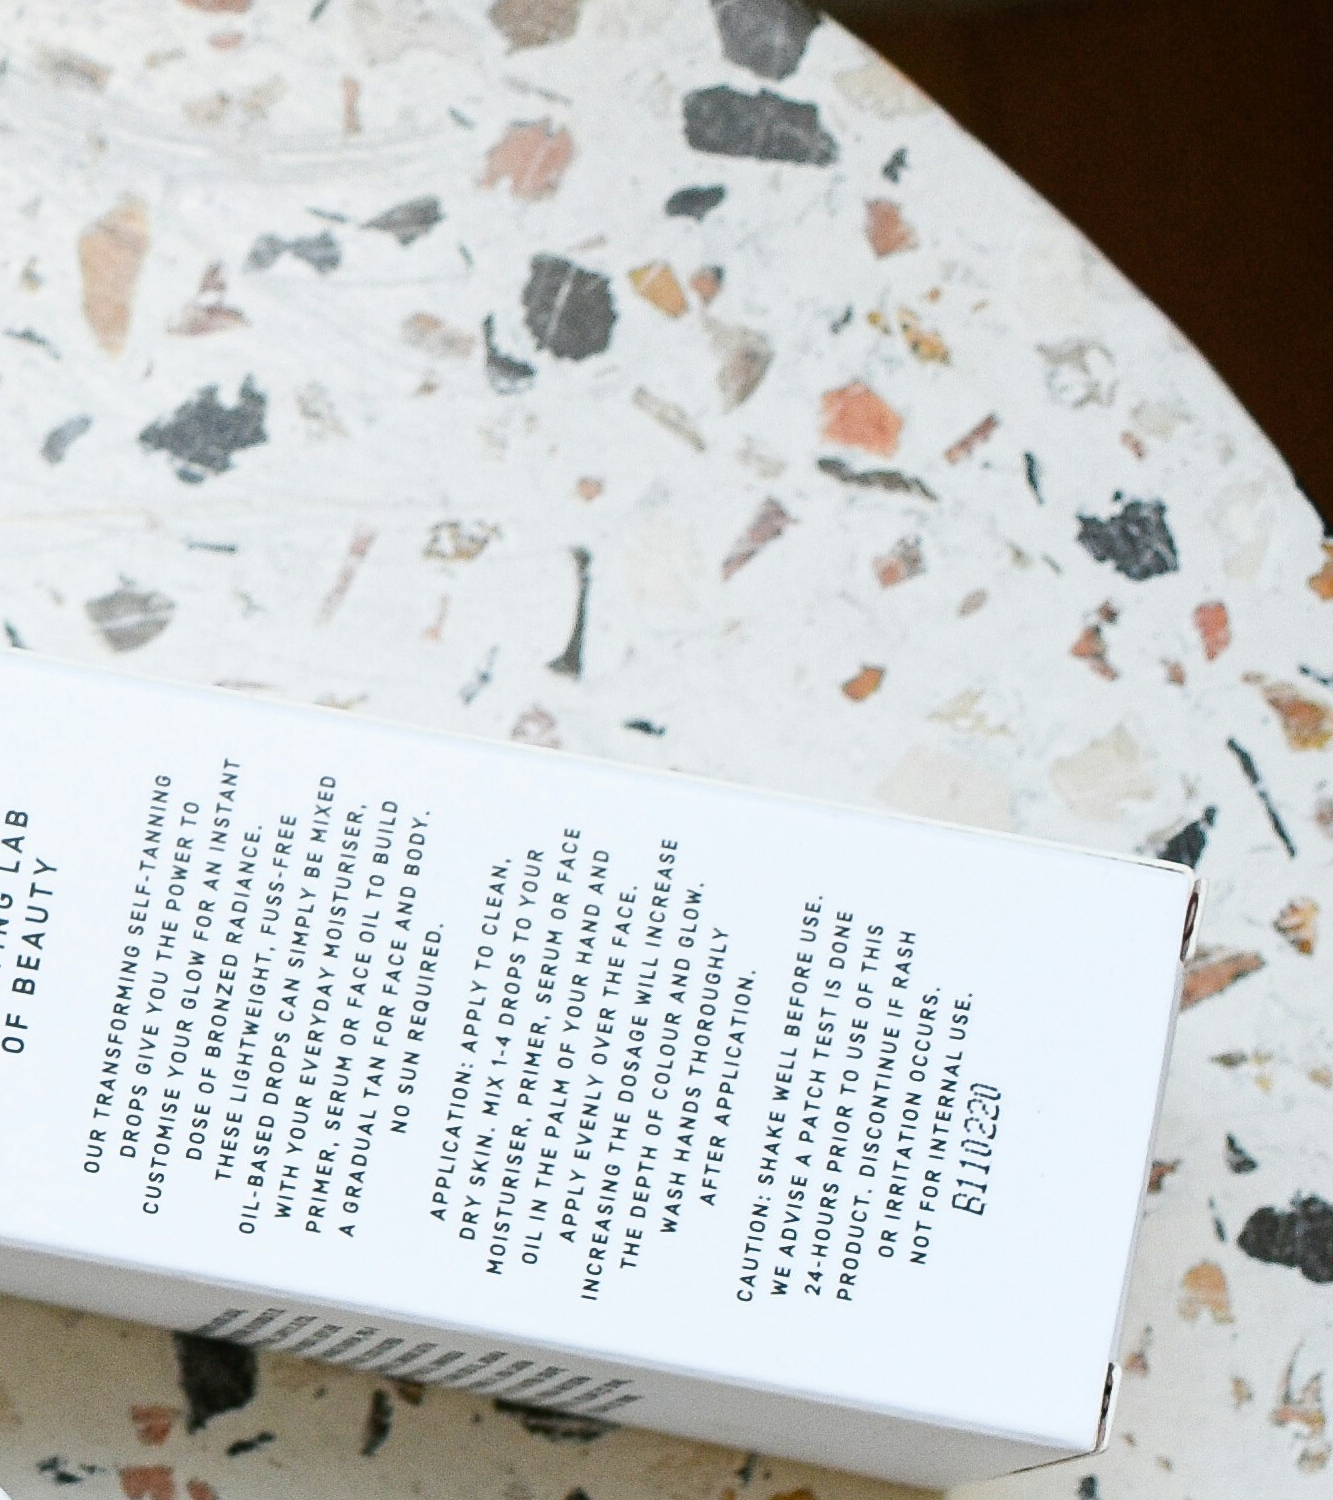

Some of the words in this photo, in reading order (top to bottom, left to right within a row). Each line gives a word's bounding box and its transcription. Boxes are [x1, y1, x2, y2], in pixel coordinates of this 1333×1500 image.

[178, 800, 200, 826] TO
[208, 757, 240, 852] INSTANT
[309, 774, 336, 843] MIXED
[371, 799, 398, 865] BUILD
[126, 773, 172, 936] SELF-TANNING
[164, 836, 194, 912] POWER
[202, 860, 222, 892] AN
[224, 824, 263, 945] RADIANCE.
[302, 851, 324, 879] BE
[321, 803, 367, 959] MOISTURISER,
[364, 873, 385, 900] TO
[555, 827, 581, 884] FACE
[191, 898, 216, 942] FOR
[480, 857, 511, 936] CLEAN,
[549, 891, 570, 920] OR
[610, 885, 638, 948] FACE.
[643, 838, 678, 948] INCREASE
[677, 882, 704, 948] GLOW.
[798, 894, 823, 943] USE.
[10, 856, 58, 996] BEAUTY
[154, 919, 179, 961] THE
[286, 886, 317, 969] SIMPLY
[357, 909, 380, 944] OIL
[473, 944, 494, 971] TO
[827, 910, 854, 970] DONE
[859, 923, 884, 973] THIS
[144, 969, 169, 1014] YOU
[179, 948, 206, 1010] GLOW
[345, 951, 372, 1009] FACE
[534, 928, 563, 1004] SERUM
[601, 955, 625, 997] THE
[633, 956, 659, 1005] WILL
[667, 957, 691, 1004] AND
[822, 978, 842, 999] IS
[890, 929, 916, 990] RASH
[203, 952, 239, 1059] BRONZED
[213, 1110, 243, 1181] THESE
[228, 946, 276, 1103] LIGHTWEIGHT,
[259, 814, 297, 936] FUSS-FREE
[276, 976, 301, 1023] CAN
[298, 965, 335, 1086] EVERYDAY
[459, 979, 488, 1054] APPLY
[687, 926, 729, 1076] THOROUGHLY
[782, 951, 814, 1037] BEFORE
[854, 981, 874, 1009] OF
[885, 997, 905, 1018] IF
[948, 991, 973, 1041] USE.
[0, 1011, 29, 1054] OF
[91, 944, 141, 1119] TRANSFORMING
[134, 1023, 160, 1075] GIVE
[166, 1018, 194, 1078] YOUR
[339, 1016, 360, 1046] OR
[516, 1014, 551, 1106] PRIMER,
[590, 1006, 617, 1066] OVER
[616, 1014, 649, 1103] DOSAGE
[650, 1011, 682, 1100] COLOUR
[712, 969, 757, 1127] APPLICATION.
[811, 1005, 837, 1059] TEST
[844, 1017, 869, 1060] USE
[907, 986, 941, 1083] OCCURS.
[196, 1066, 217, 1095] OF
[261, 1031, 291, 1106] DROPS
[323, 1054, 353, 1131] SERUM
[771, 1046, 798, 1101] WELL
[838, 1068, 860, 1095] TO
[118, 1083, 148, 1159] DROPS
[184, 1102, 212, 1161] DOSE
[284, 1094, 313, 1154] YOUR
[572, 1073, 604, 1161] EVENLY
[606, 1111, 631, 1153] THE
[643, 1108, 664, 1136] OF
[672, 1085, 702, 1162] HANDS
[797, 1068, 827, 1144] PATCH
[857, 1025, 900, 1178] DISCONTINUE
[927, 1050, 963, 1160] INTERNAL
[82, 1128, 107, 1174] OUR
[141, 1087, 181, 1215] CUSTOMISE
[428, 1061, 474, 1222] APPLICATION:
[698, 1134, 727, 1207] AFTER
[756, 1110, 786, 1186] SHAKE
[793, 1153, 812, 1168] A
[825, 1104, 854, 1173] PRIOR
[882, 1091, 922, 1221] IRRITATION
[237, 1114, 275, 1235] OIL-BASED
[273, 1163, 300, 1218] WITH
[304, 1141, 340, 1234] PRIMER,
[484, 1117, 533, 1275] MOISTURISER,
[558, 1168, 587, 1244] APPLY
[628, 1144, 658, 1219] DEPTH
[658, 1170, 687, 1233] WASH
[918, 1168, 942, 1212] FOR
[579, 1162, 621, 1301] INCREASING
[618, 1226, 643, 1269] THE
[735, 1194, 771, 1302] CAUTION:
[777, 1174, 808, 1258] ADVISE
[802, 1181, 840, 1296] 24-HOURS
[835, 1188, 873, 1302] PRODUCT.
[876, 1228, 898, 1258] OR
[908, 1219, 933, 1265] NOT
[769, 1264, 792, 1295] WE
